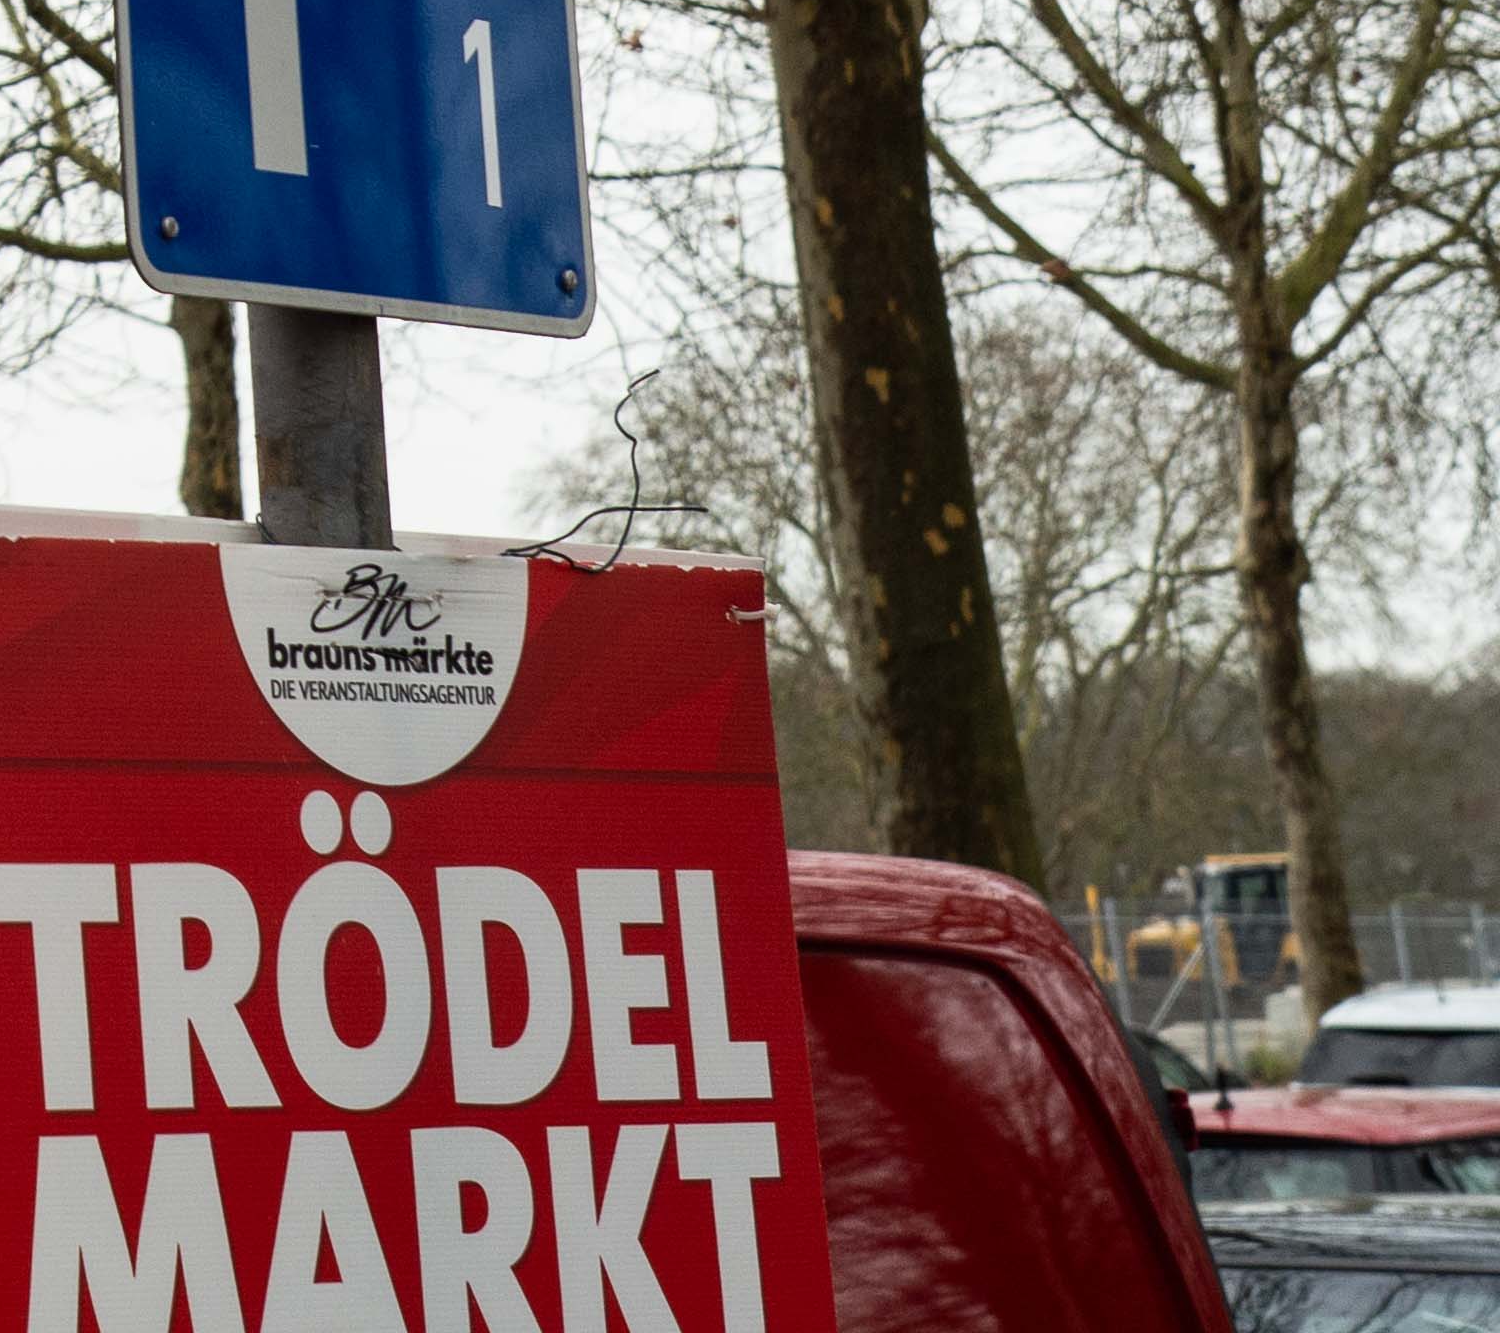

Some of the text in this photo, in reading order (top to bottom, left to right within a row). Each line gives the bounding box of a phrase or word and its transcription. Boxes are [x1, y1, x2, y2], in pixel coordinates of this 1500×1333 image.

[461, 18, 503, 208] 1
[270, 679, 497, 705] DIE VERANSTALTUNGSAGENTUR
[26, 1122, 782, 1333] MARKT
